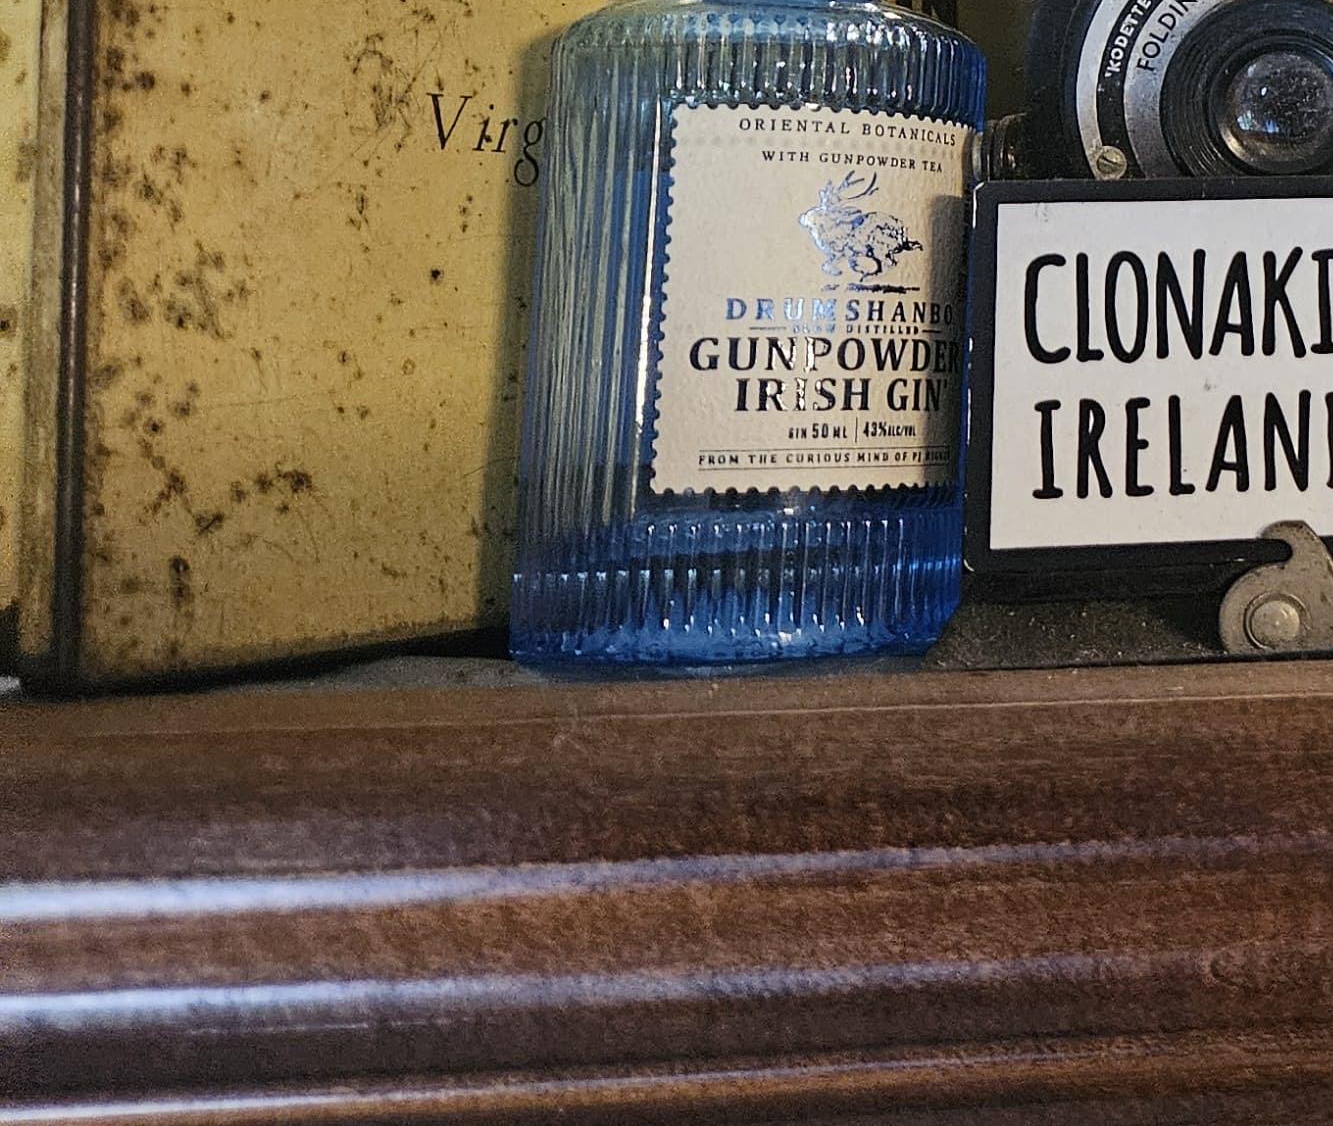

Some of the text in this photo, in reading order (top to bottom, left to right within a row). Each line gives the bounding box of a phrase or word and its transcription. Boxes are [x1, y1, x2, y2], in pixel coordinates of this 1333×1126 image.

[739, 118, 956, 146] ORIENTAL BOTANICALS
[762, 150, 943, 173] WITH GUNPOWDER TEA
[725, 298, 952, 324] DRUMSHANBO
[689, 336, 960, 373] GUNPOWDER
[734, 377, 870, 412] IRISH
[788, 427, 807, 439] GIN
[812, 423, 829, 439] 50
[699, 454, 739, 465] FROM
[750, 454, 777, 464] THE
[786, 452, 850, 464] CURIOUS
[857, 452, 889, 463] MIND
[894, 452, 908, 462] OF
